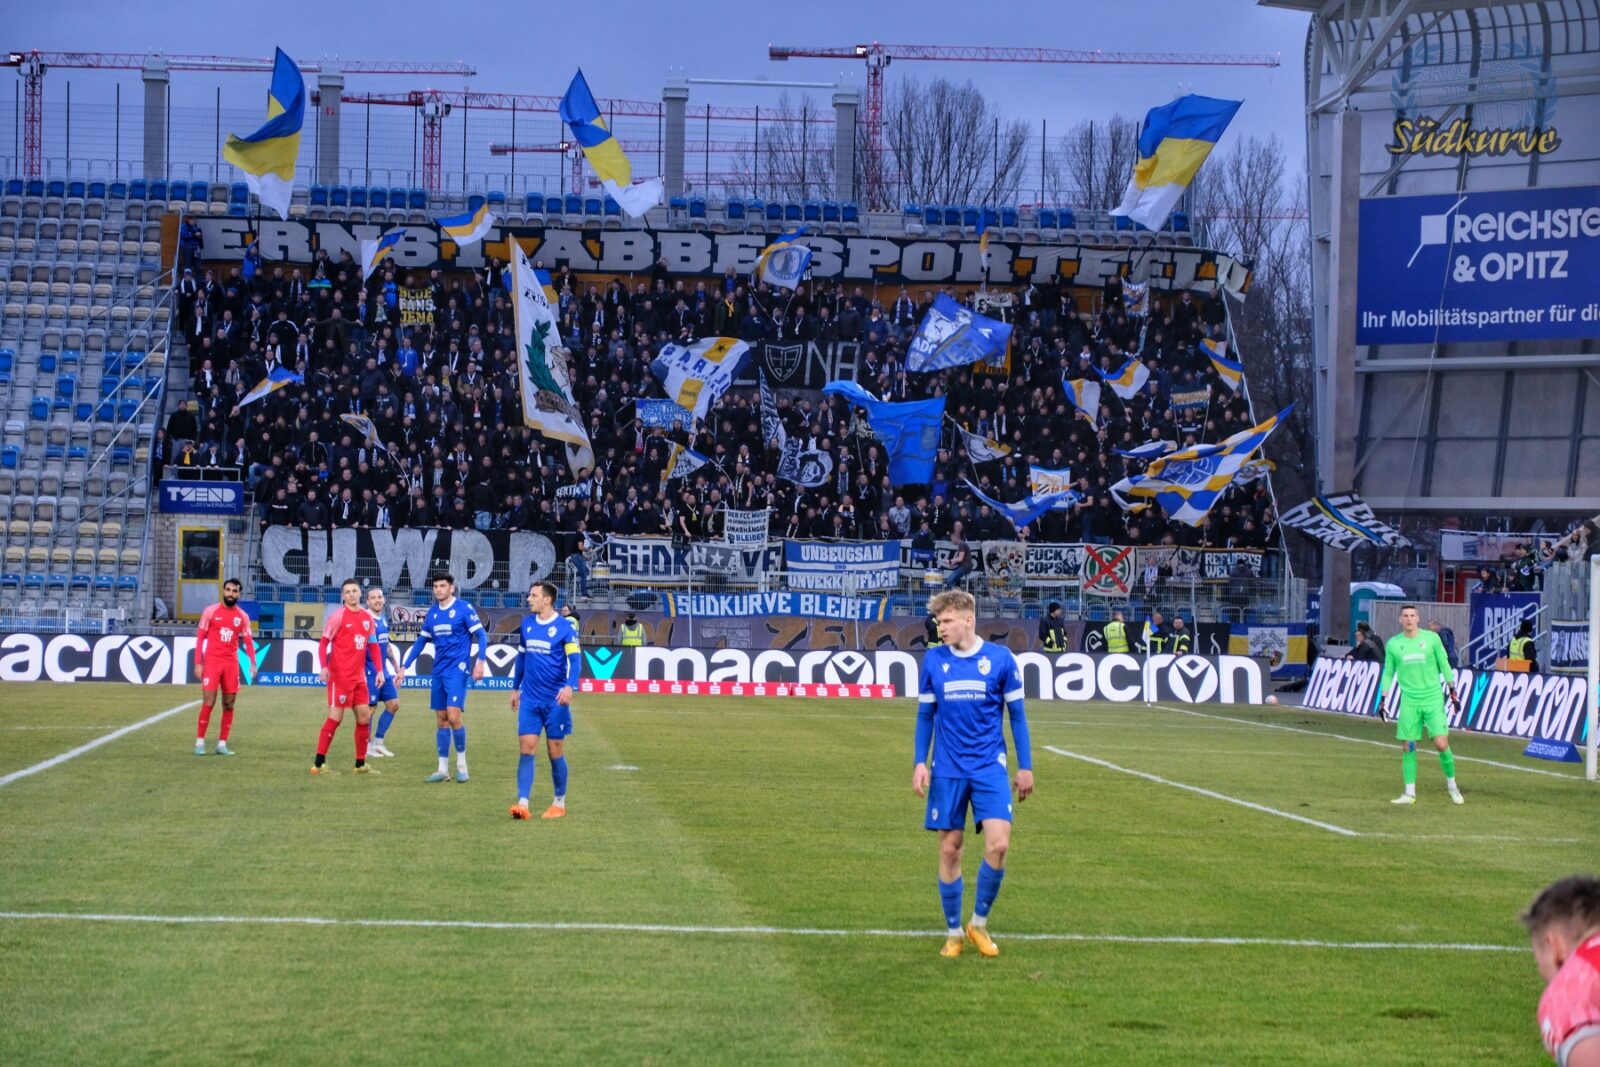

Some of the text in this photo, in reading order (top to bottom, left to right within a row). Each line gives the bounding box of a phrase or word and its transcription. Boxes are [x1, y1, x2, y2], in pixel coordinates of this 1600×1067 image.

[1386, 117, 1562, 155] Südkurve
[530, 230, 766, 274] ABBE
[1453, 250, 1568, 282] & OPITZ
[401, 311, 434, 324] JENA
[1362, 311, 1386, 328] Ihr
[1391, 307, 1544, 328] Mobilitätspartner
[1549, 305, 1576, 322] für
[167, 486, 236, 503] TREND
[801, 544, 884, 562] UNBEUGSAM
[1025, 549, 1063, 561] FUCK
[1025, 562, 1063, 574] COPS
[678, 592, 877, 620] SÜDKURVE BLEIBT
[636, 646, 919, 697] macron
[1303, 656, 1381, 714] macron
[1478, 670, 1588, 742] macron
